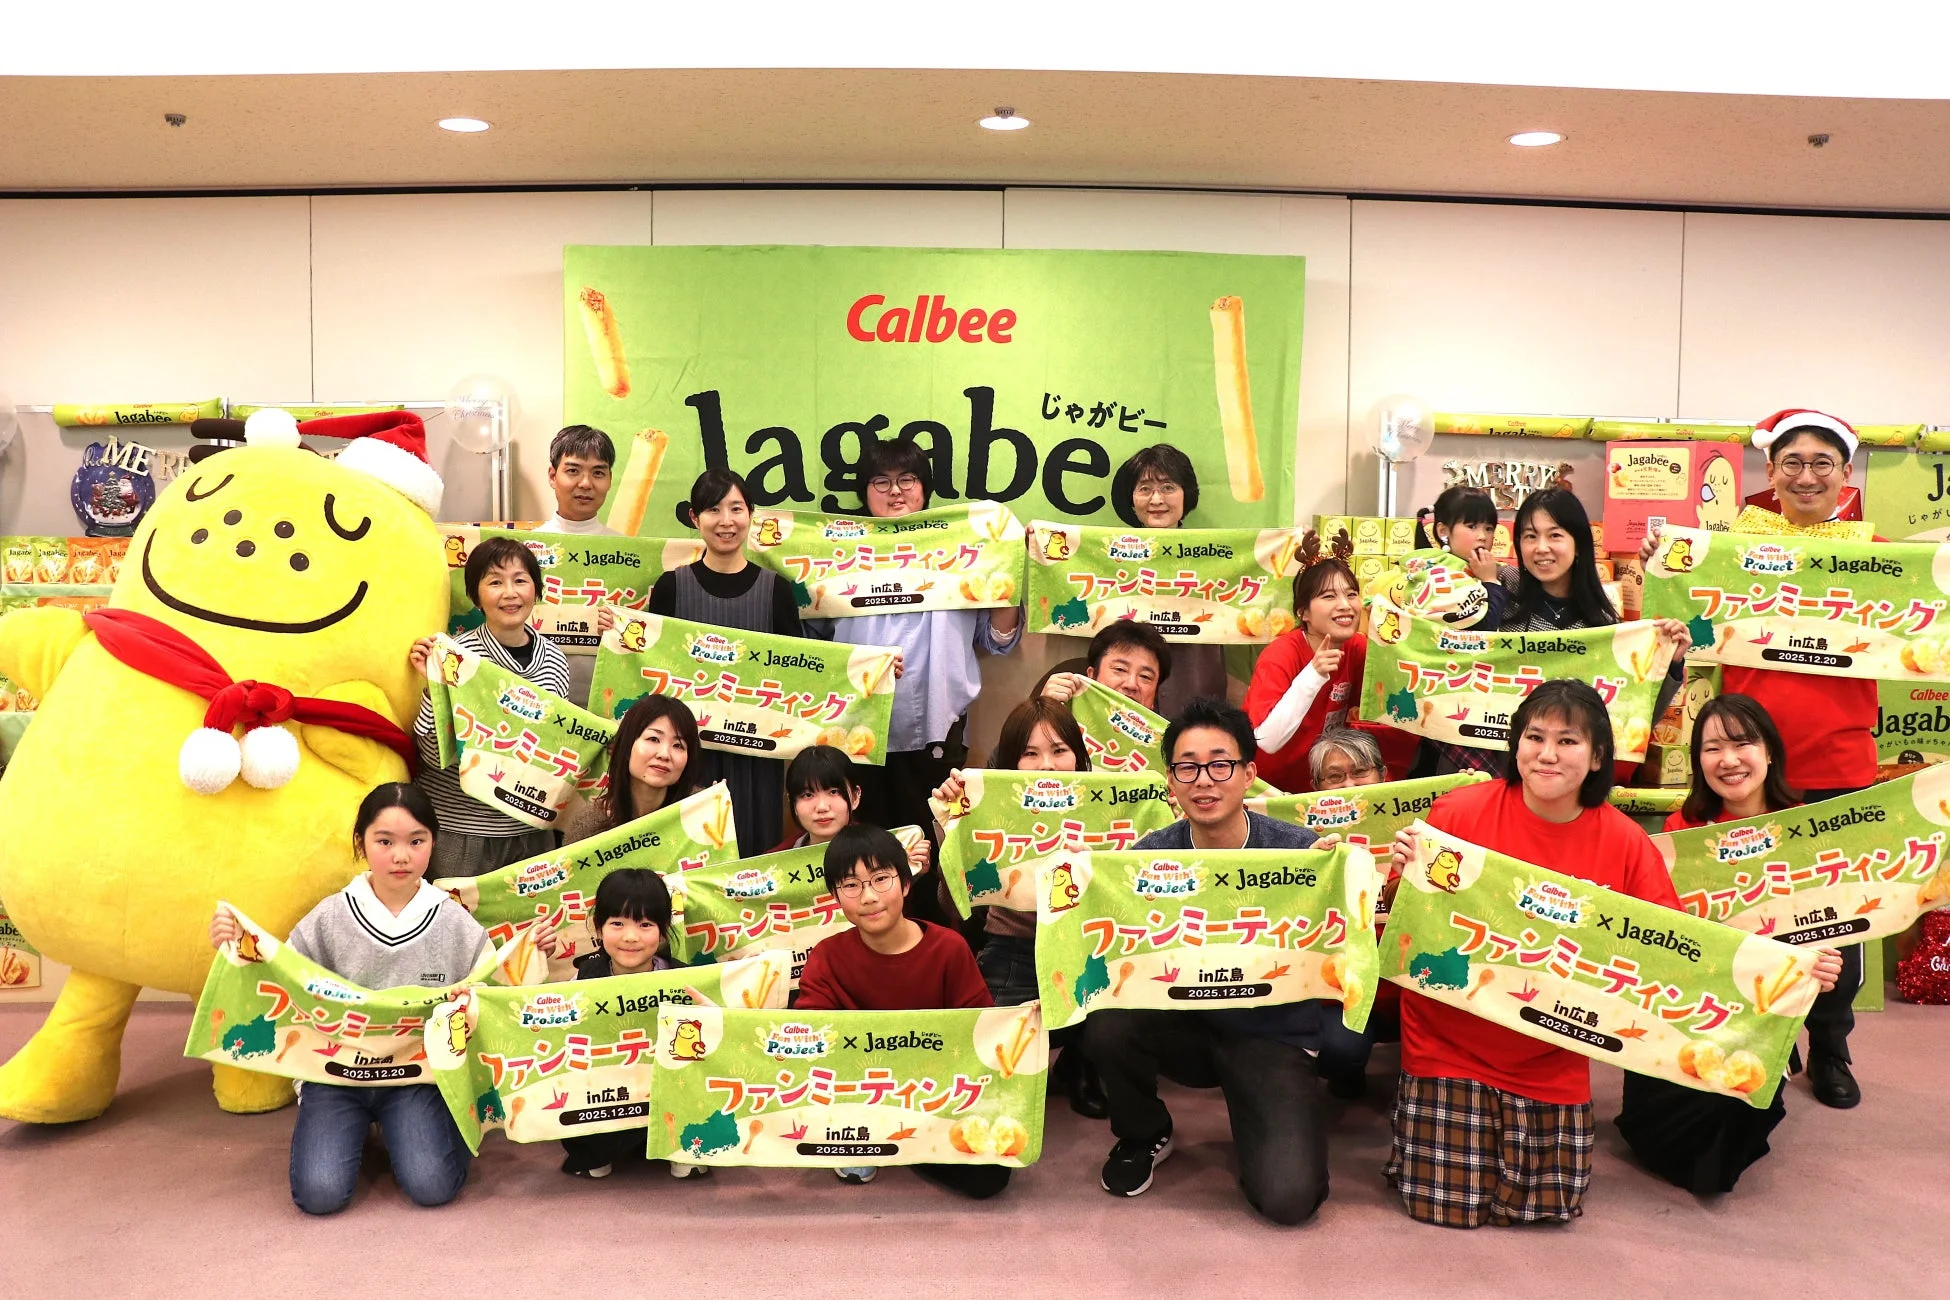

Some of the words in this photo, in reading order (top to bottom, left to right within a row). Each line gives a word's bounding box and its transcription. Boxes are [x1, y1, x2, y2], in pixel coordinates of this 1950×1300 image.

[846, 294, 1017, 344] Calbee
[1042, 392, 1167, 433] じゃがビー
[675, 386, 1133, 529] Jagabe
[1628, 454, 1669, 466] Jagabee
[825, 528, 866, 538] Project
[892, 520, 948, 534] Jagabee
[583, 550, 641, 568] Jagabee
[1110, 548, 1150, 558] Project
[1176, 544, 1234, 560] Jagabee
[785, 544, 984, 582] ファンミーティング
[1744, 558, 1794, 571] Project
[1828, 556, 1903, 578] Jagabee
[871, 583, 902, 594] in広島
[1070, 570, 1266, 603] ファンミーティング
[864, 596, 912, 606] 2025.12.20
[1692, 584, 1942, 633] ファンミーティング
[1150, 611, 1181, 622] in広島
[556, 621, 589, 633] in広島
[549, 636, 598, 644] 2025.12.20
[706, 636, 726, 644] Calbee
[1440, 640, 1486, 650] Project
[1518, 636, 1586, 654] Jagabee
[1788, 636, 1828, 651] in広島
[692, 647, 736, 662] Project
[764, 650, 825, 673] Jagabee
[1778, 652, 1836, 666] 2025.12.20
[518, 687, 537, 700] Calbee
[642, 669, 853, 721] ファンミーティング
[1910, 688, 1949, 700] Calbee
[500, 694, 543, 721] Project
[1128, 712, 1146, 726] Calbee
[1484, 712, 1509, 725] in広
[566, 718, 611, 746] Jagab
[723, 720, 758, 734] in広島
[1110, 714, 1152, 744] Project
[714, 734, 764, 748] 2025.12.20
[514, 781, 548, 804] in広島
[1038, 781, 1060, 789] Calbee
[504, 794, 550, 818] 2025.12.20
[1024, 794, 1074, 808] Project
[1320, 798, 1342, 806] Calbee
[1306, 810, 1357, 826] Project
[1808, 808, 1886, 838] Jagabee
[1730, 828, 1754, 838] Calbee
[596, 834, 660, 868] Jagabee
[1720, 836, 1772, 859] Project
[526, 862, 548, 874] Calbee
[737, 870, 758, 879] Calbee
[1154, 862, 1178, 872] Calbee
[518, 870, 566, 894] Project
[1137, 878, 1196, 893] Project
[1236, 866, 1316, 890] Jagabee
[726, 880, 774, 898] Project
[1541, 884, 1567, 898] Calbee
[1520, 894, 1579, 924] Project
[686, 894, 844, 952] ファンミーテ
[1794, 908, 1838, 927] in広島
[1616, 917, 1702, 963] Jagabee
[1788, 924, 1853, 944] 2025.12.20
[1198, 968, 1244, 983] in広島
[1452, 914, 1740, 1033] ファンミーティング
[1188, 987, 1256, 998] 2025.12.20
[536, 996, 561, 1005] Calbee
[616, 989, 692, 1016] Jagabee
[522, 1008, 578, 1025] Project
[1553, 1000, 1600, 1029] in広島
[784, 1024, 810, 1034] Calbee
[1538, 1014, 1605, 1046] 2025.12.20
[766, 1041, 824, 1055] Project
[864, 1031, 944, 1053] Jagabee
[343, 1068, 406, 1079] 2025.12.20
[586, 1086, 630, 1104] in広島
[708, 1070, 989, 1114] ファンミーティング
[578, 1106, 642, 1121] 2025.12.20
[826, 1127, 870, 1142] in広島
[816, 1146, 882, 1154] 2025.12.20
